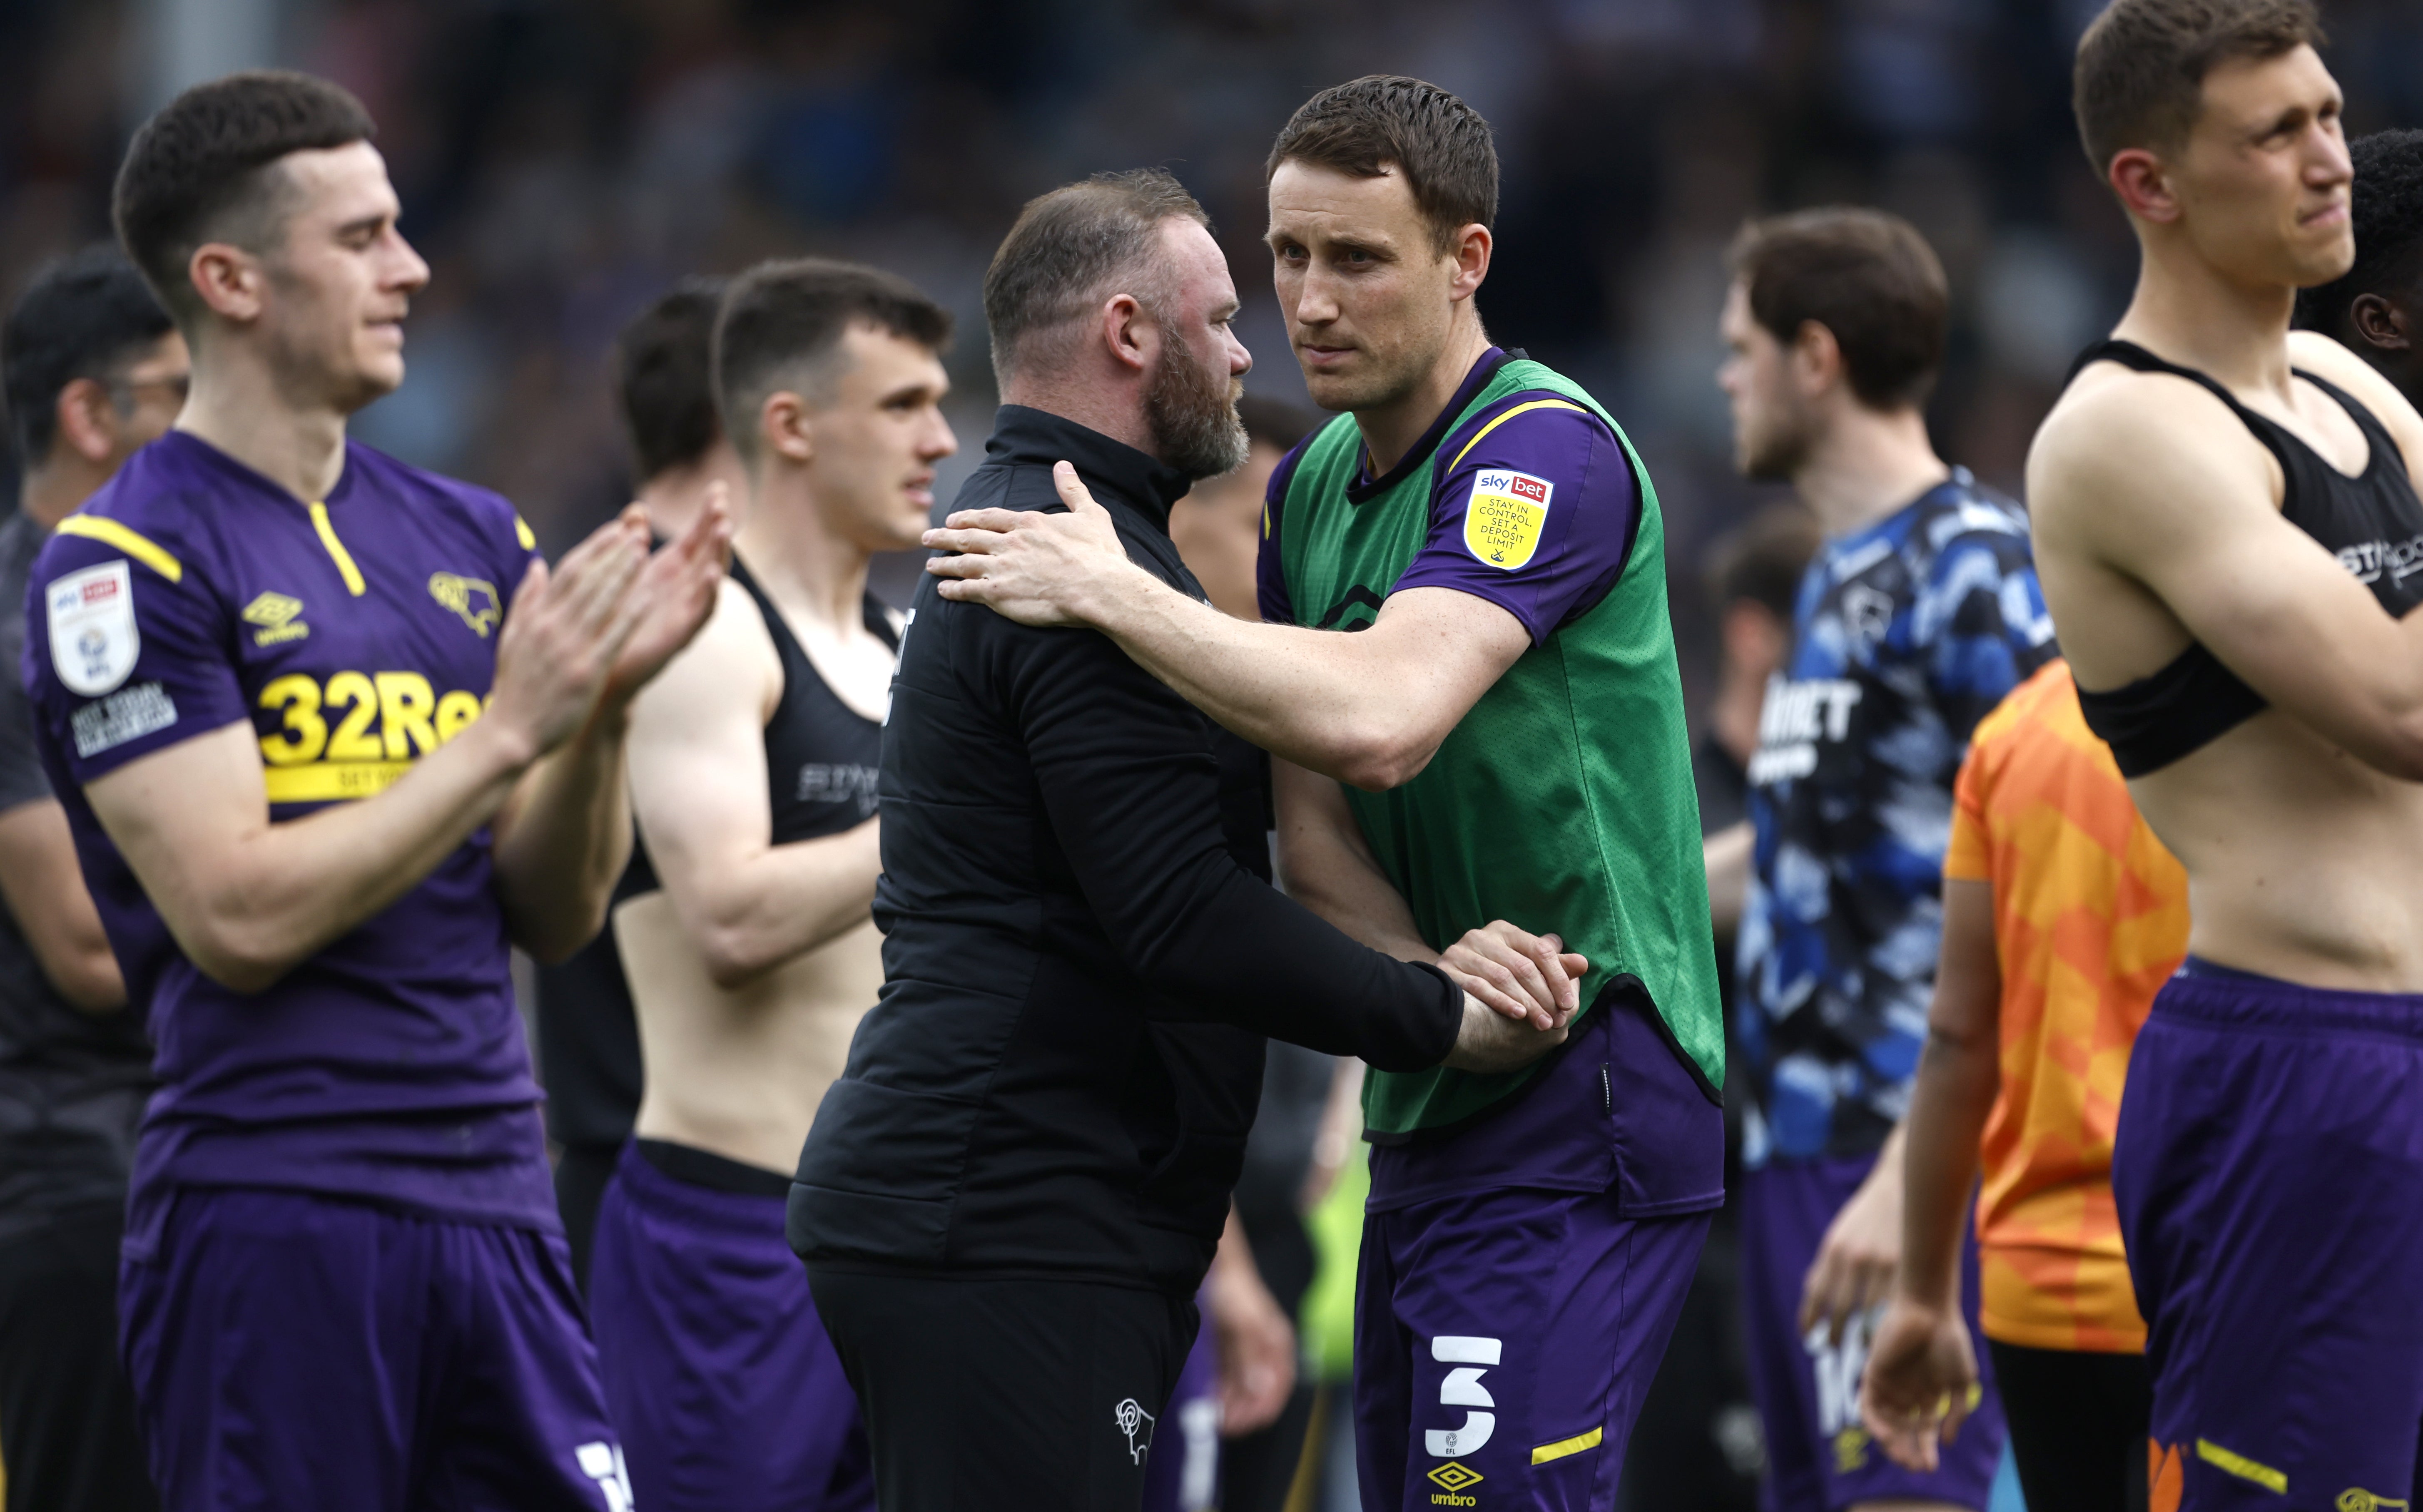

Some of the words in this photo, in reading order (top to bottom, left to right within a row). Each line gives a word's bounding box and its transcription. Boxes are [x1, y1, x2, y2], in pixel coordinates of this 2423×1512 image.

[1481, 475, 1510, 490] sky
[1515, 478, 1543, 498] bet
[1489, 499, 1514, 510] STAY
[1517, 505, 1528, 514] IN
[1479, 507, 1532, 527] CONTROL.
[1492, 518, 1510, 528] SET
[1481, 525, 1524, 543] DEPOSIT
[1487, 536, 1515, 550] LIMIT
[259, 670, 493, 766] 32Re
[1425, 1336, 1502, 1457] 3
[1431, 1492, 1477, 1507] umbro
